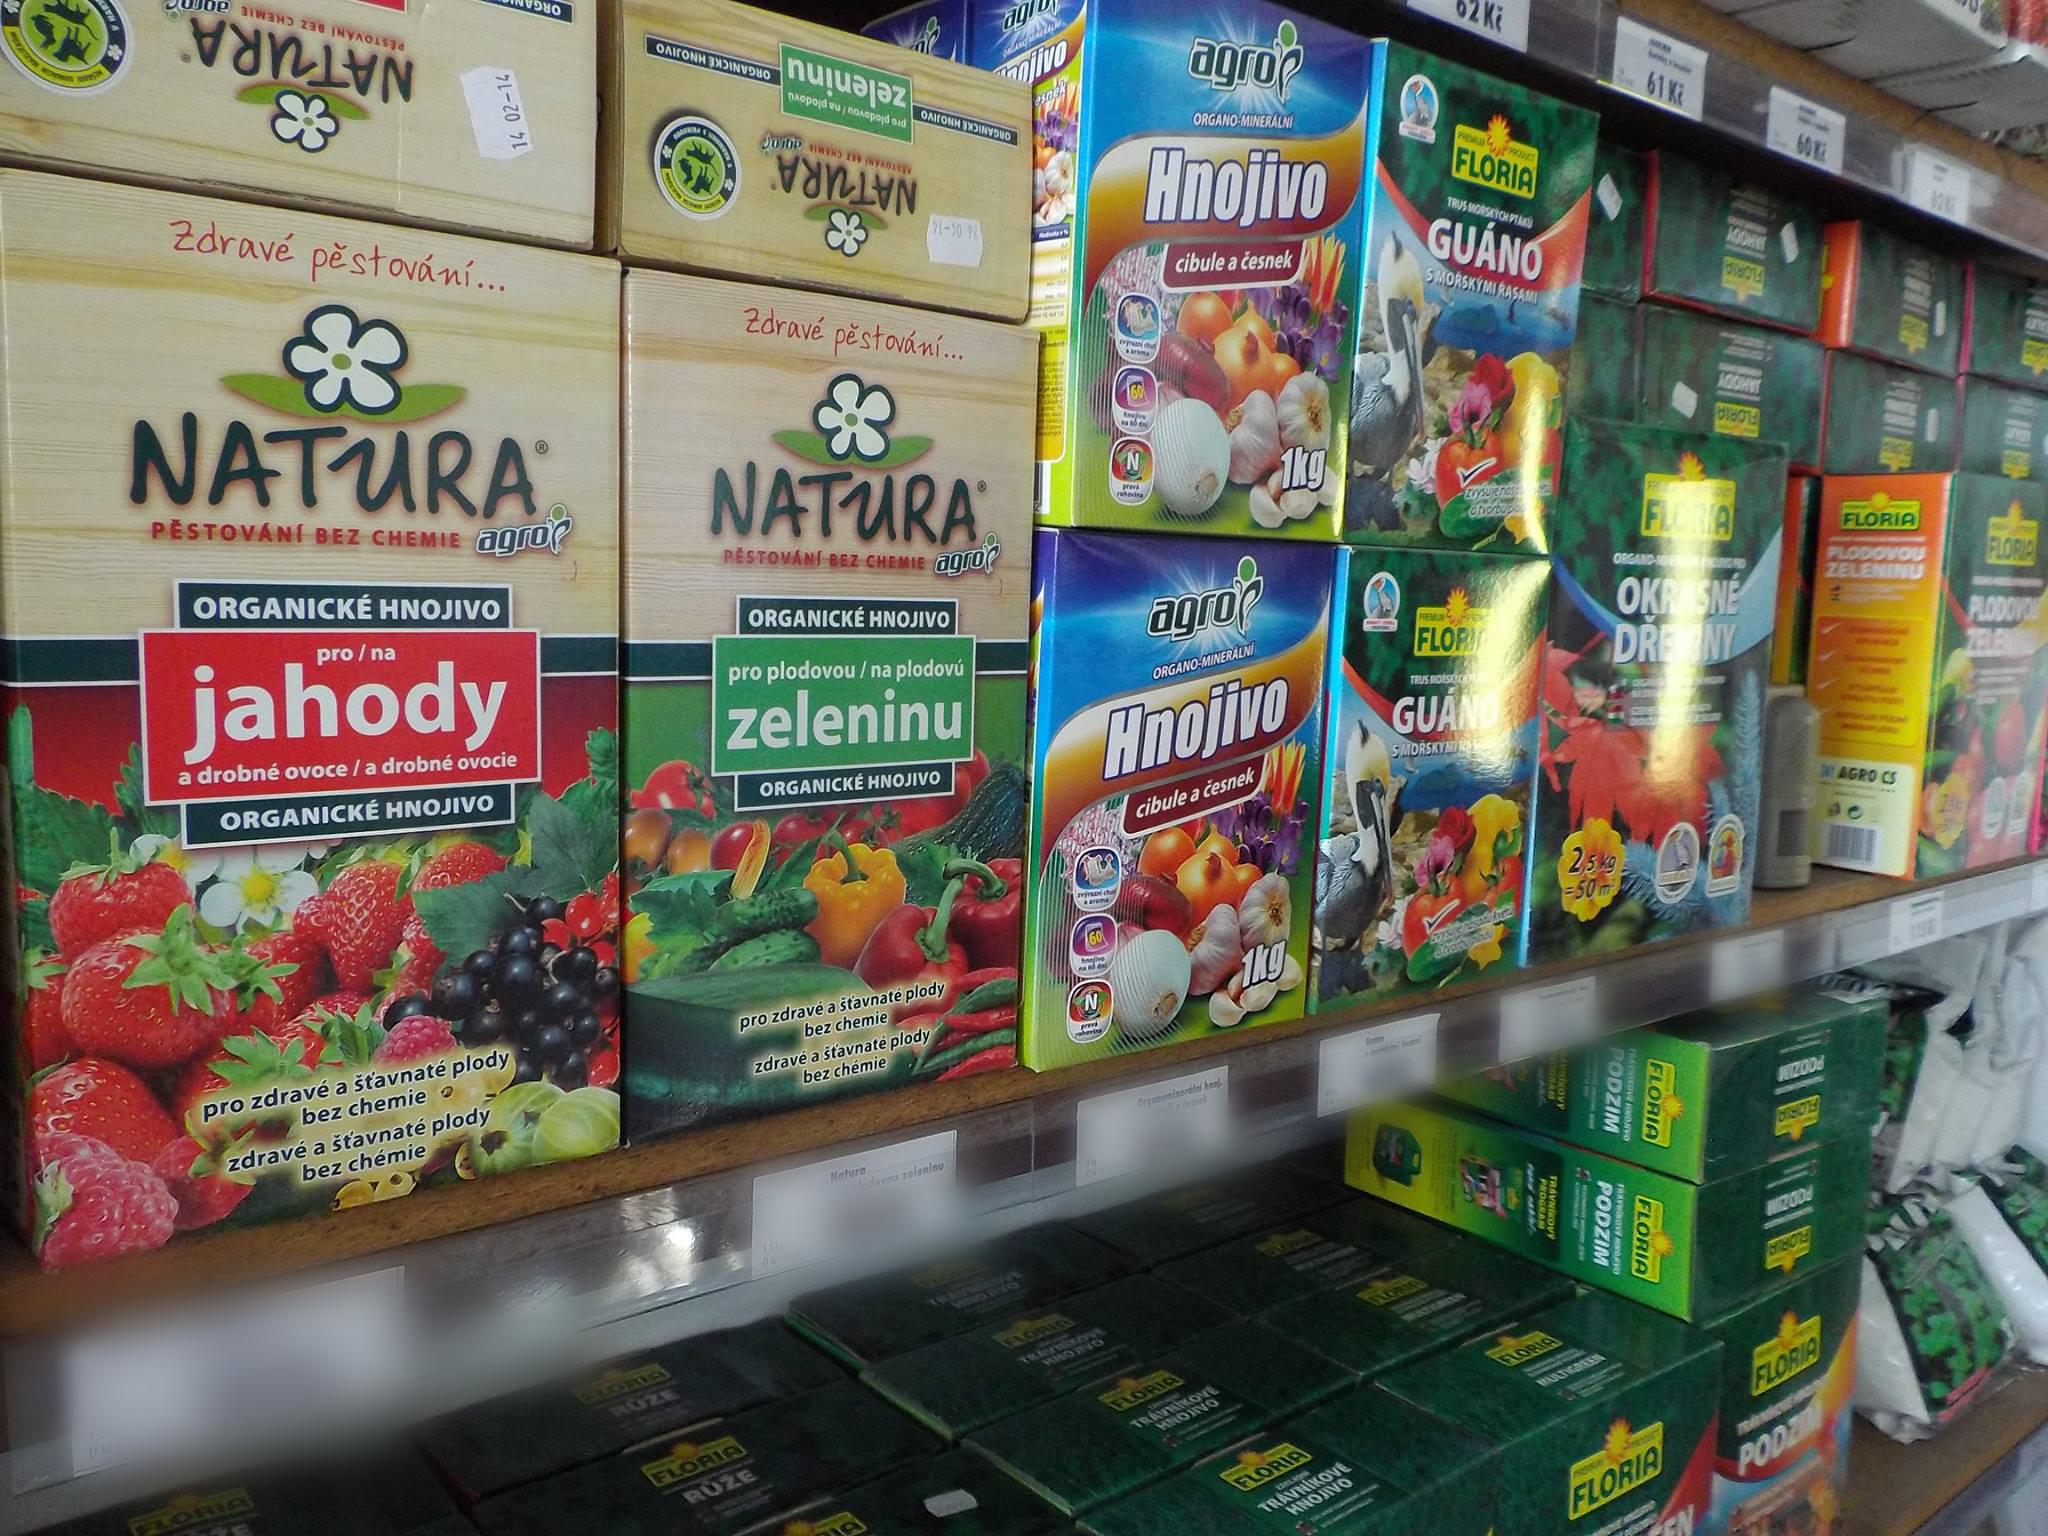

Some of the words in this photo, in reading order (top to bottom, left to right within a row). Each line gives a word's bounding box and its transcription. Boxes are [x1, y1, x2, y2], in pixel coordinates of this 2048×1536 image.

[240, 5, 294, 27] CHEMIE
[299, 18, 326, 34] BEZ
[1483, 2, 1504, 32] Kč
[331, 25, 405, 52] PĚSTOVÁNÍ
[655, 42, 708, 67] HNOJIVO
[191, 18, 414, 104] NATURA
[709, 54, 771, 81] ORGANICKÉ
[786, 57, 907, 109] zeleninu
[1647, 70, 1665, 98] 61
[1668, 79, 1685, 107] Kč
[829, 102, 840, 113] na
[847, 106, 891, 125] plodovou
[891, 116, 907, 128] pro
[920, 109, 961, 130] HNOJIVO
[1193, 111, 1294, 130] ORGANO-MINERÁLNÍ
[961, 119, 1012, 142] ORGANICKÉ
[775, 155, 918, 217] NATURA
[1143, 146, 1329, 229] Hnojivo
[1455, 146, 1534, 194] FLORIA
[1447, 196, 1468, 213] TRUS
[169, 218, 295, 264] Zdravé
[1426, 217, 1543, 282] GUÁNO
[1175, 251, 1226, 275] cibule
[1227, 258, 1236, 271] a
[1240, 250, 1293, 271] česnek
[1426, 268, 1434, 283] S
[743, 307, 825, 341] Zdravé
[1130, 384, 1144, 400] 60
[130, 411, 537, 520] NATURA
[1126, 451, 1140, 472] N
[1281, 446, 1327, 491] 1kg
[710, 461, 976, 546] NATURA
[1843, 511, 1916, 528] FLORIA
[151, 518, 304, 545] PĚSTOVÁNÍ
[314, 525, 361, 546] BEZ
[371, 528, 461, 549] CHEMIE
[723, 547, 822, 569] PĚSTOVÁNÍ
[828, 554, 859, 569] BEZ
[865, 553, 925, 570] CHEMIE
[192, 593, 373, 622] ORGANICKÉ
[379, 598, 501, 622] HNOJIVO
[1616, 572, 1741, 616] OKRSNÉ
[747, 605, 865, 629] ORGANICKÉ
[869, 609, 951, 629] HNOJIVO
[316, 646, 354, 667] pro
[370, 646, 396, 662] na
[1612, 615, 1738, 664] DŘENY
[728, 665, 762, 687] pro
[766, 661, 856, 685] plodovou
[870, 663, 892, 678] na
[896, 658, 965, 683] plodovú
[1151, 641, 1256, 681] ORGANO-MINERÁLNÍ
[183, 660, 508, 765] jahody
[726, 689, 962, 751] zeleninu
[1102, 676, 1289, 780] Hnojivo
[1391, 687, 1500, 735] GUÁNO
[178, 770, 193, 787] a
[197, 761, 280, 786] drobné
[284, 761, 348, 780] ovoce
[365, 760, 378, 776] a
[381, 752, 454, 776] drobné
[457, 751, 518, 770] ovocie
[1391, 743, 1400, 759] S
[758, 773, 864, 798] ORGANICKÉ
[867, 770, 942, 790] HNOJIVO
[1135, 786, 1187, 820] cibule
[1190, 787, 1201, 802] a
[1203, 766, 1255, 799] česnek
[1837, 766, 1877, 783] AGRO
[1881, 770, 1897, 786] CS
[219, 801, 380, 832] ORGANICKÉ
[384, 794, 495, 821] HNOJIVO
[1088, 930, 1102, 947] 60
[1241, 940, 1287, 989] 1kg
[739, 1013, 768, 1033] pro
[770, 1001, 825, 1026] zdravé
[827, 1002, 838, 1014] a
[839, 987, 903, 1013] šťavnaté
[904, 981, 946, 1006] plody
[1084, 993, 1098, 1012] N
[803, 1020, 833, 1038] bez
[835, 1010, 889, 1033] chemie
[754, 1048, 808, 1074] zdravé
[810, 1049, 821, 1064] a
[823, 1034, 888, 1062] šťavnaté
[889, 1028, 931, 1054] plody
[202, 1097, 245, 1123] pro
[250, 1079, 331, 1112] zdravé
[334, 1081, 350, 1099] a
[353, 1059, 448, 1095] šťavnaté
[451, 1048, 510, 1086] plody
[802, 1065, 832, 1085] bez
[834, 1055, 888, 1080] chémie
[301, 1101, 342, 1126] bez
[346, 1087, 427, 1120] chemie
[1602, 1047, 1625, 1134] PODZIM
[1642, 1060, 1664, 1140] FLORIA
[226, 1141, 308, 1175] zdravé
[311, 1141, 327, 1159] a
[331, 1116, 426, 1154] šťavnaté
[430, 1105, 491, 1141] plody
[301, 1157, 342, 1183] bez
[346, 1141, 427, 1175] chémie
[1592, 1180, 1614, 1268] PODZIM
[1634, 1197, 1652, 1276] FLORIA
[1754, 1335, 1820, 1391] FLORIA
[1108, 1376, 1178, 1410] FLORIA
[1154, 1398, 1220, 1431] HNOJIVO
[651, 1444, 747, 1487] FLORIA
[1234, 1450, 1309, 1489] FLORIA
[1572, 1445, 1661, 1512] FLORIA
[1285, 1478, 1354, 1517] HNOJIVO
